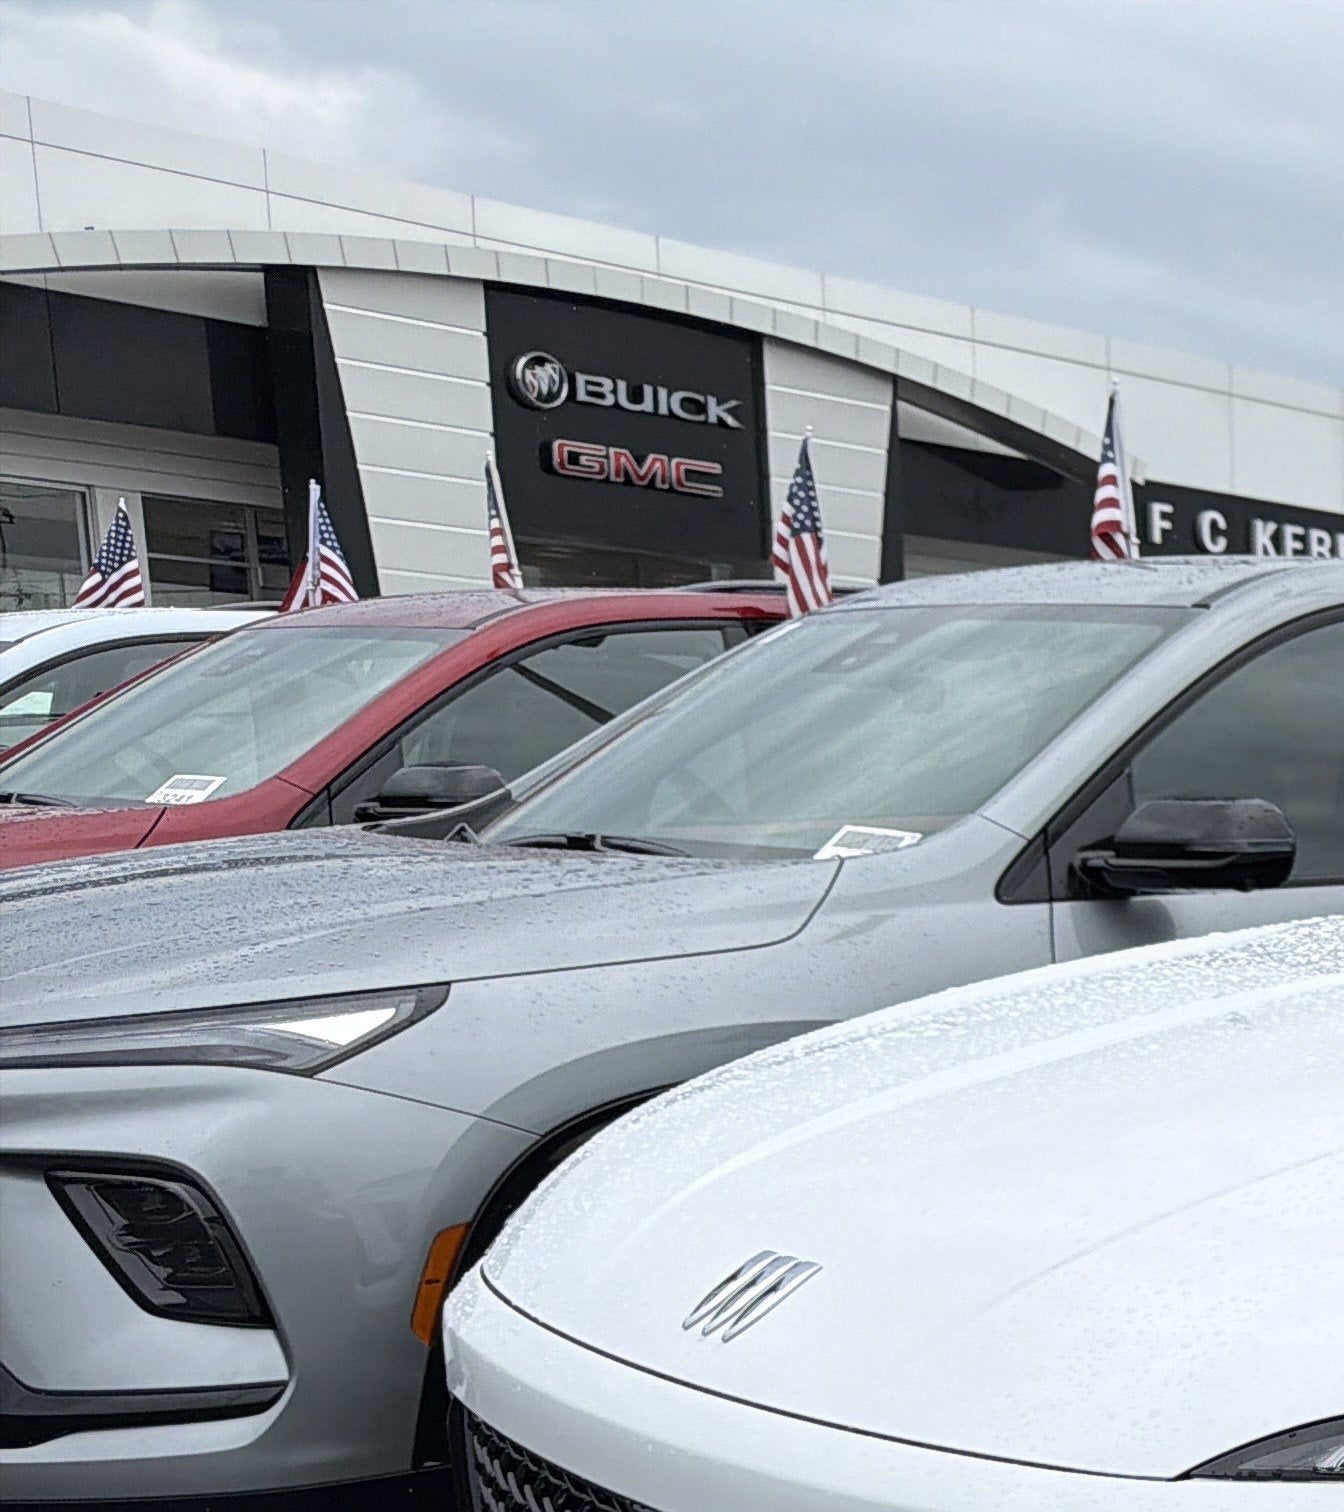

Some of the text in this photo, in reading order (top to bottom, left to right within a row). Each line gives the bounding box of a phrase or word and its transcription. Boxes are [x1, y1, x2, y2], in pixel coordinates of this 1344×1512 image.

[575, 371, 746, 430] BUICK
[552, 438, 723, 498] GMC
[1147, 501, 1174, 545] F
[1197, 509, 1229, 553] C
